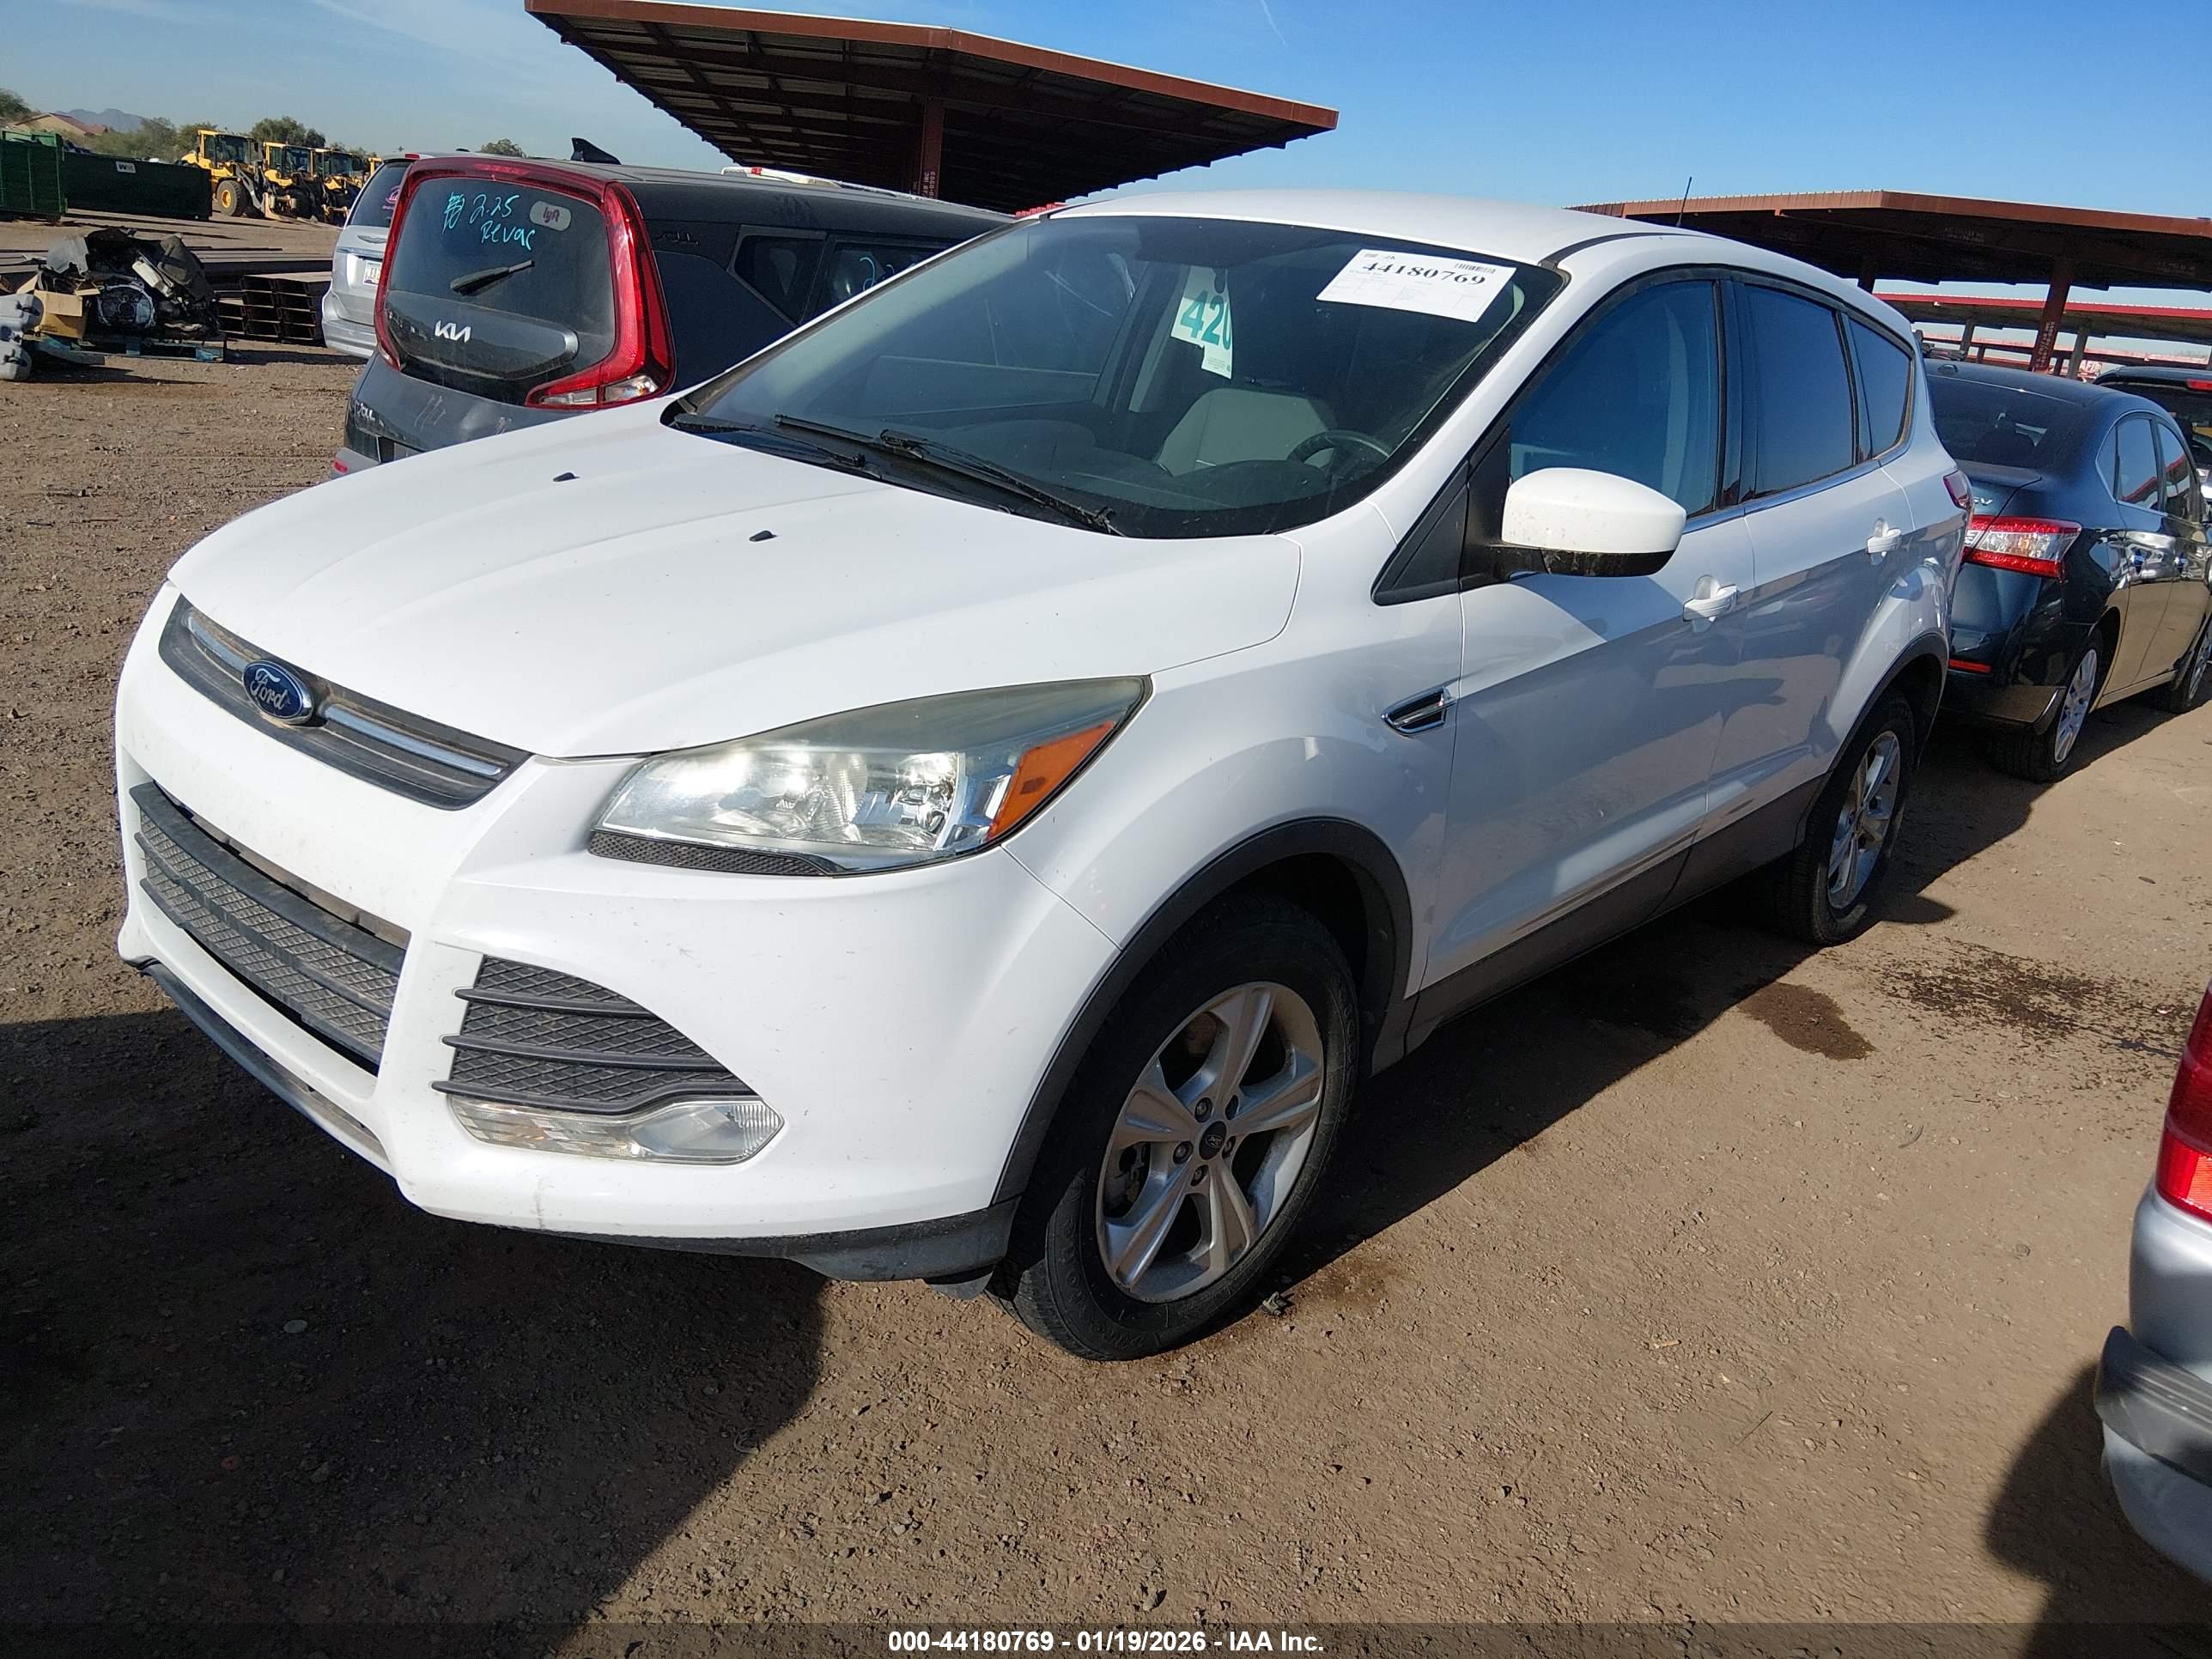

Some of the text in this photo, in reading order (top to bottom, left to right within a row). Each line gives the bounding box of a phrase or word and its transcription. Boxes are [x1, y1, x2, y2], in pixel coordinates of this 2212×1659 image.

[470, 194, 520, 223] 2.25
[543, 207, 560, 223] lyft
[1363, 262, 1486, 285] 44180769
[434, 320, 471, 343] KIA
[250, 668, 289, 710] Ford
